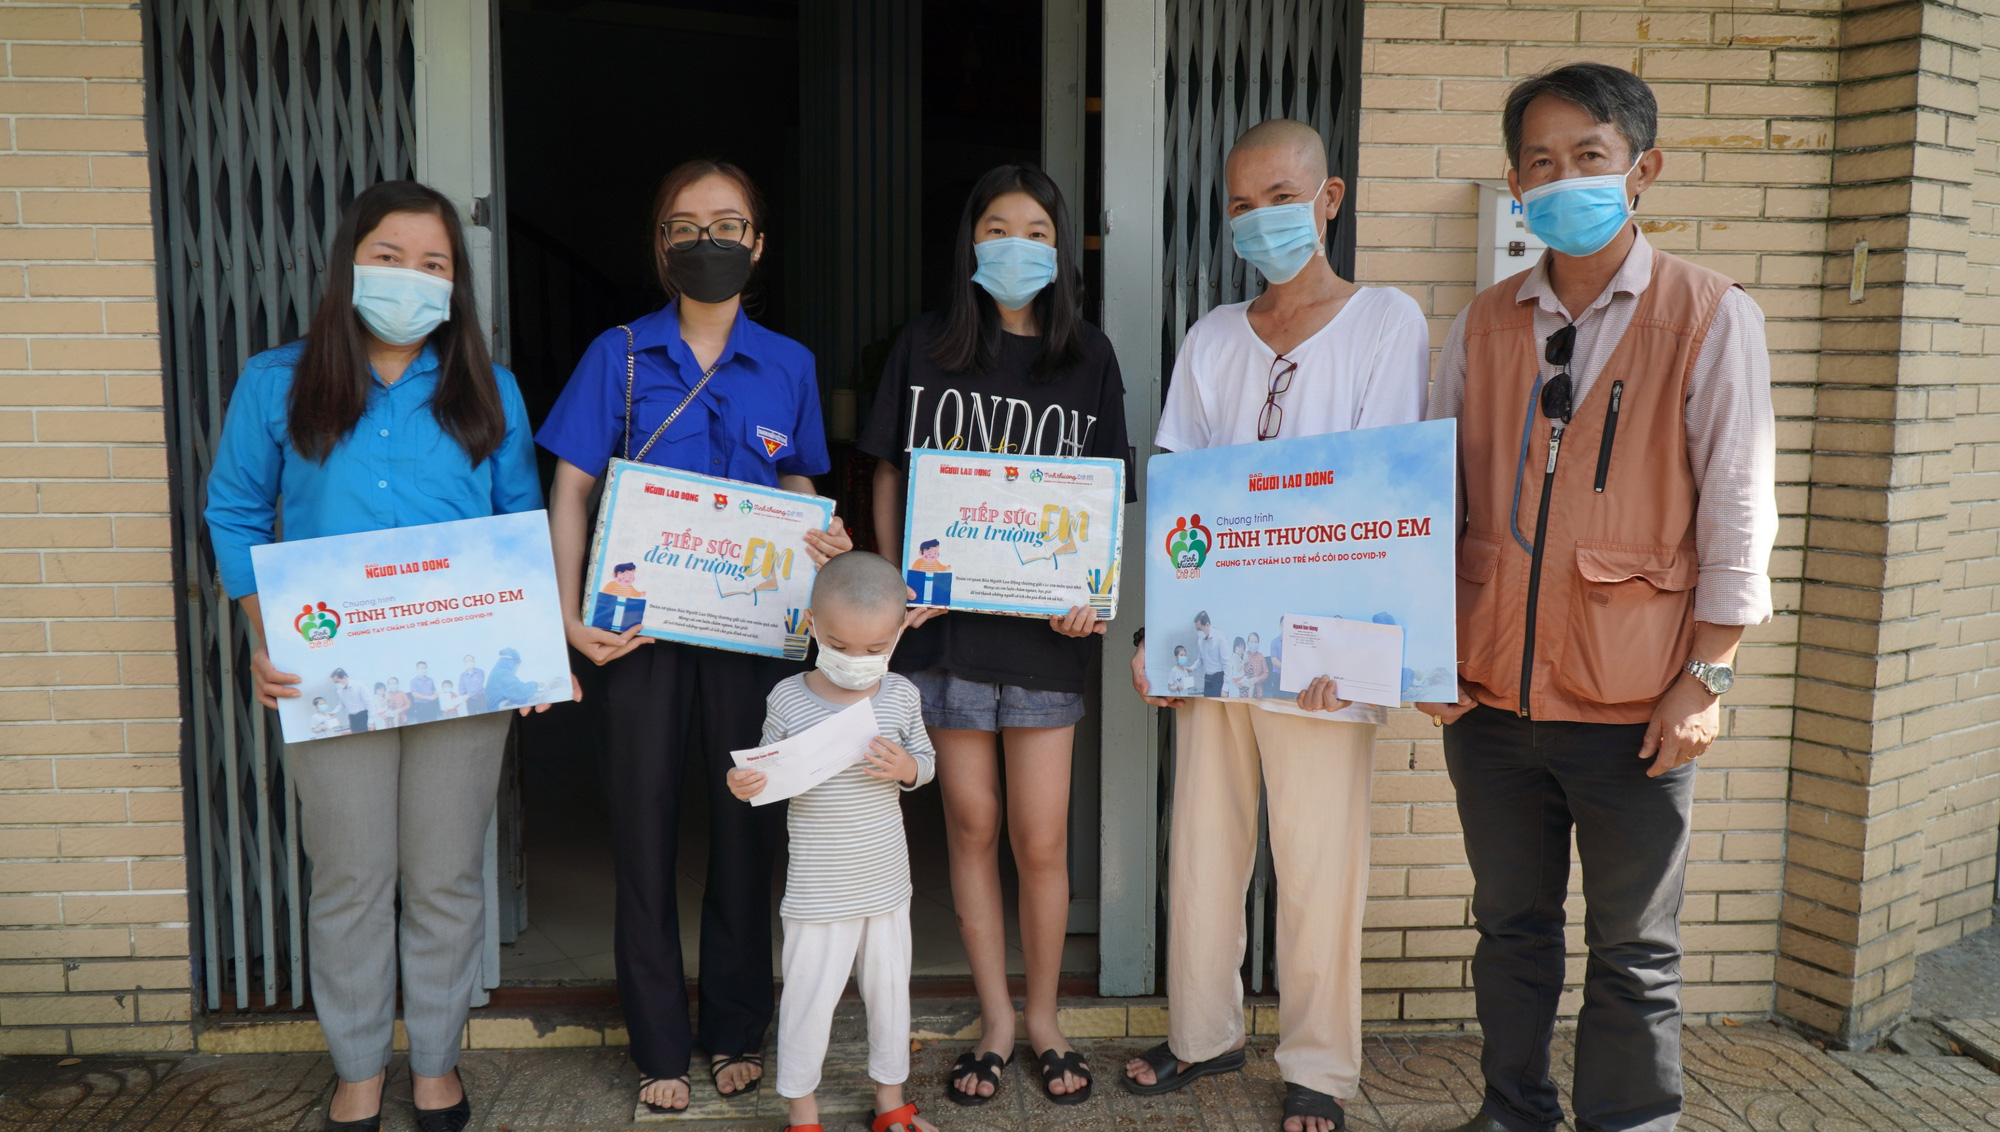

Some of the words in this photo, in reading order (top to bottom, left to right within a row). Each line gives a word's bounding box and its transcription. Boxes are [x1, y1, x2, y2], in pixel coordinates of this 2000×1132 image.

[905, 385, 1097, 457] LONDON
[960, 467, 973, 476] LAO
[1282, 474, 1302, 489] LAO
[666, 489, 680, 499] LAO
[960, 501, 999, 523] TIẾP
[1003, 508, 1037, 526] SỨC
[661, 528, 703, 551] TIẾP
[706, 538, 742, 558] SỨC
[945, 515, 979, 540] đến
[984, 525, 1047, 548] trường
[1216, 528, 1261, 549] TÌNH
[1264, 524, 1346, 546] THƯƠNG
[1350, 520, 1393, 541] CHO
[1396, 517, 1431, 538] EM
[400, 562, 419, 575] LAO
[643, 541, 680, 567] đến
[684, 553, 750, 581] trường
[1215, 560, 1241, 568] CHUNG
[1337, 553, 1349, 561] DO
[1351, 551, 1387, 560] COVID-19
[345, 607, 387, 624] TÌNH
[389, 598, 459, 618] THƯƠNG
[462, 593, 495, 608] CHO
[498, 589, 524, 603] EM
[347, 629, 371, 637] CHUNG
[465, 612, 493, 621] COVID-19
